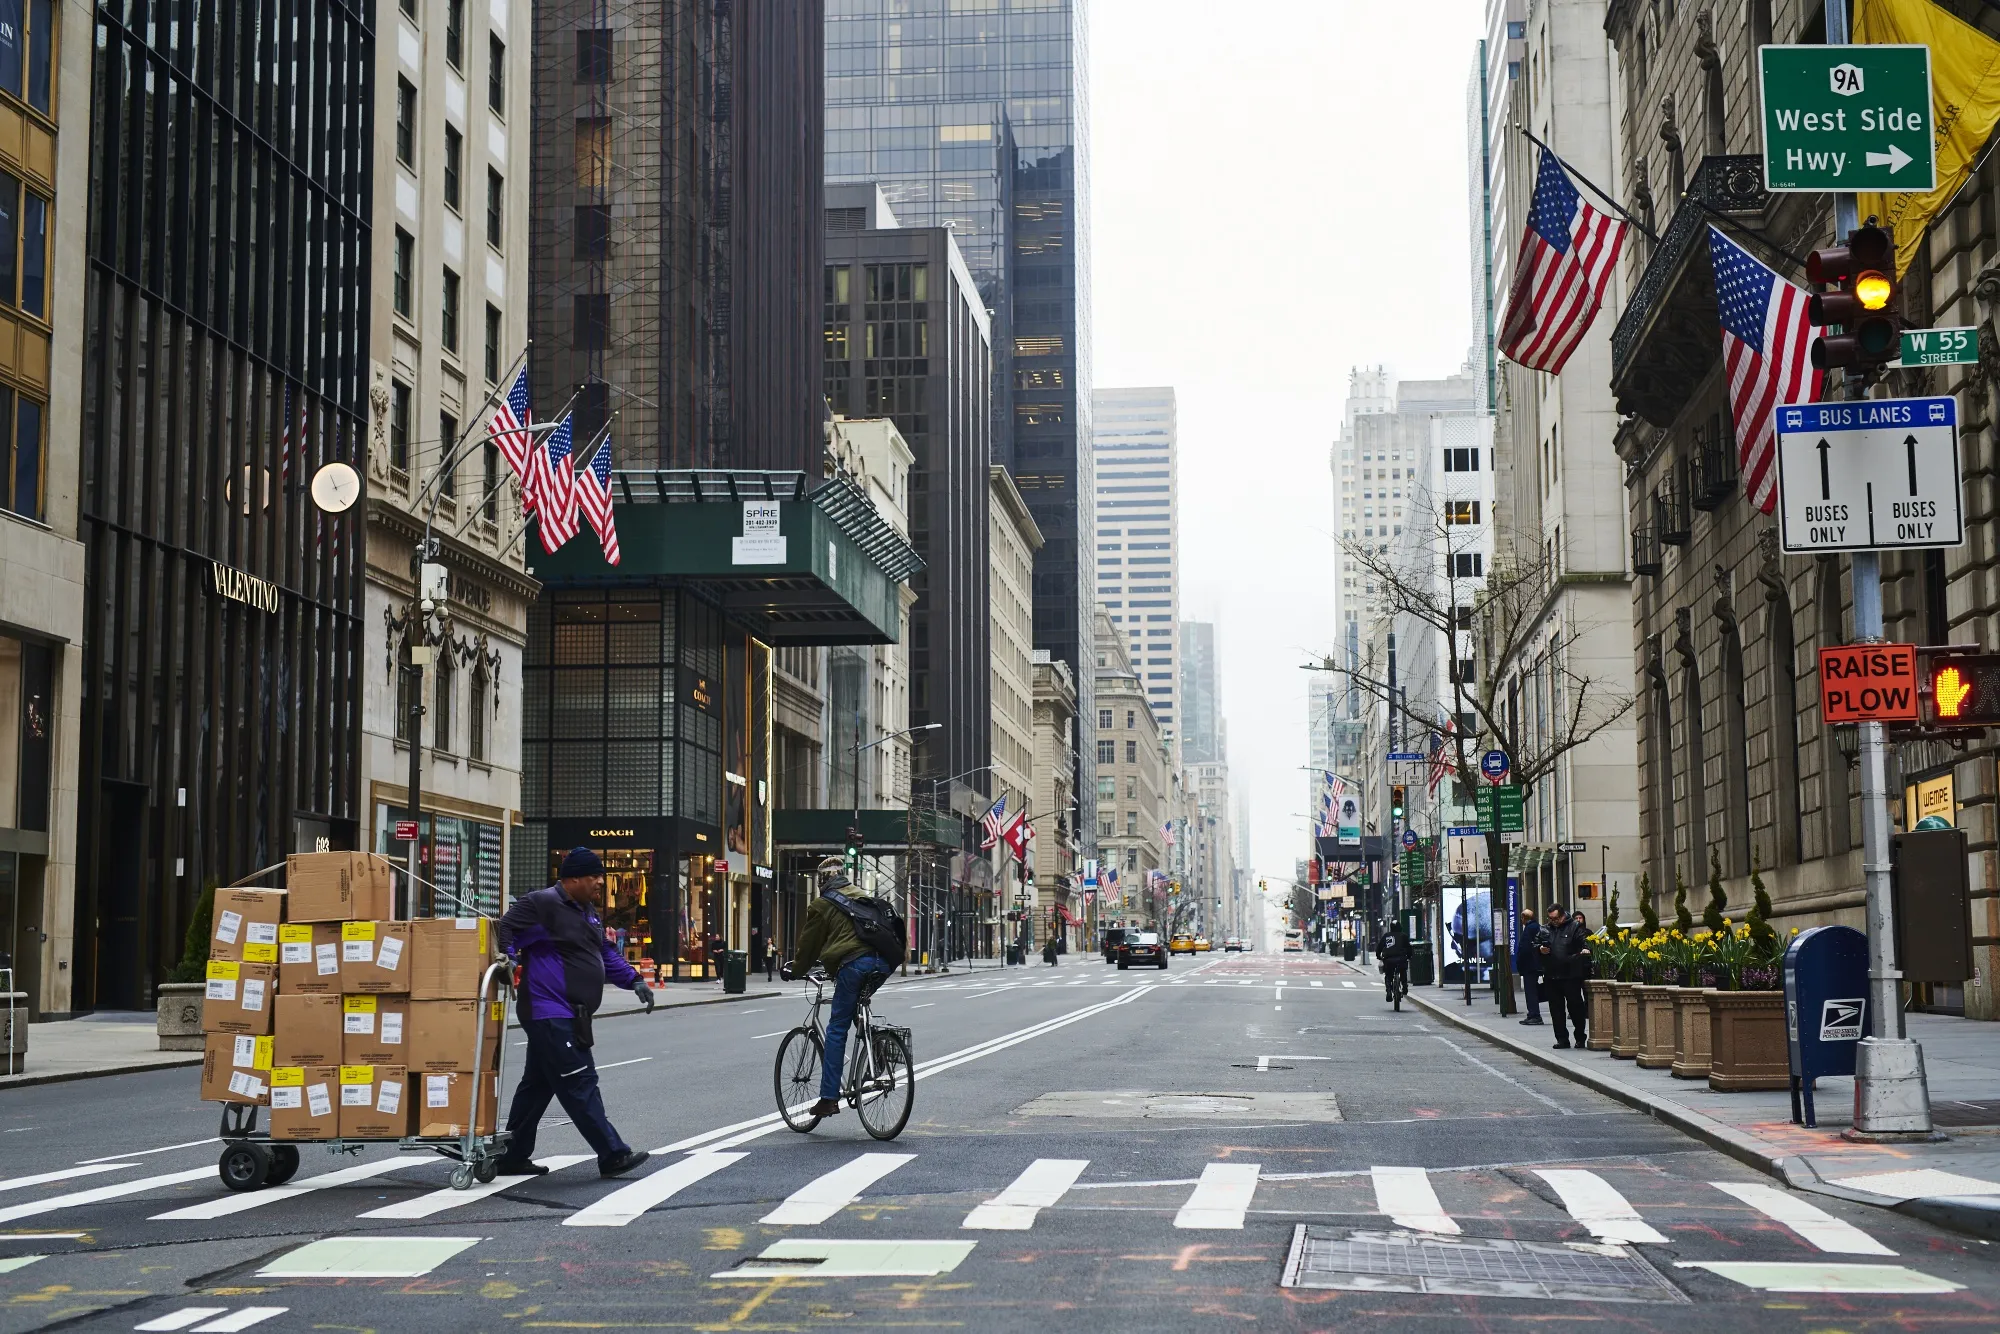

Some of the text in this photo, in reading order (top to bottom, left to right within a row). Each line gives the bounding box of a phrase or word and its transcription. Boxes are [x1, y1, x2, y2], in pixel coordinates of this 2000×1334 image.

[1834, 69, 1860, 90] 9A
[1776, 108, 1922, 131] West Side
[1936, 104, 1960, 137] BAR
[1786, 148, 1847, 176] Hwy
[1911, 331, 1968, 352] W 55
[1920, 352, 1959, 364] STREET
[1820, 406, 1912, 426] BUS LANES
[746, 506, 778, 518] SPIRE
[1806, 504, 1848, 522] BUSES
[1892, 501, 1936, 518] BUSES
[1810, 526, 1846, 543] ONLY
[1897, 523, 1934, 540] ONLY
[213, 562, 278, 614] VALENTINO
[454, 577, 491, 612] AVENUE
[1825, 653, 1910, 680] RAISE
[694, 689, 711, 706] COACH
[1827, 686, 1910, 714] PLOW
[1923, 787, 1948, 807] WEMPE
[461, 887, 474, 907] 689
